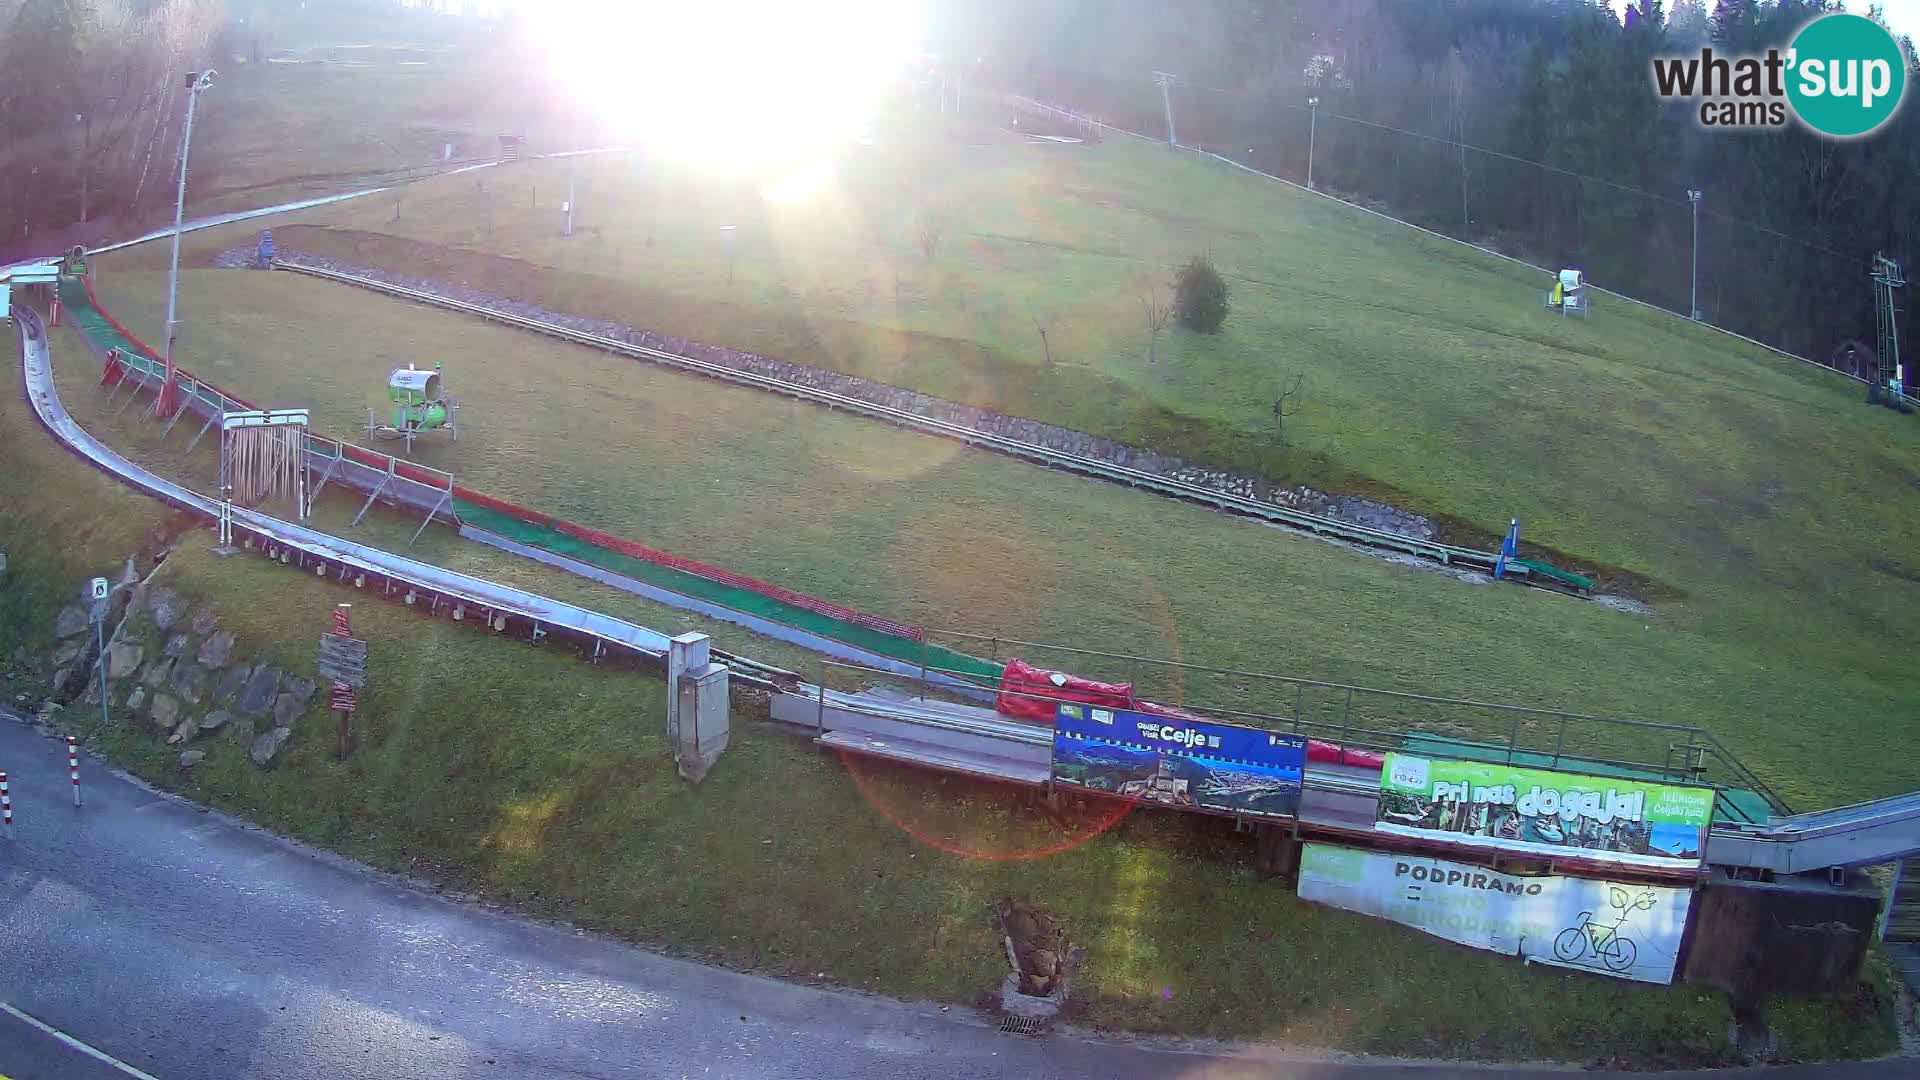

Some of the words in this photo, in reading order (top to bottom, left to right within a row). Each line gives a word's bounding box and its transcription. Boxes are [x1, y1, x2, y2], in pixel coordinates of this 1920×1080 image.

[1142, 730, 1159, 740] Visit
[1160, 726, 1206, 748] Celje
[1432, 780, 1469, 803] Pri
[1473, 784, 1516, 805] nas
[1517, 785, 1645, 825] dogaja!
[1395, 862, 1543, 896] PODPIRAMO
